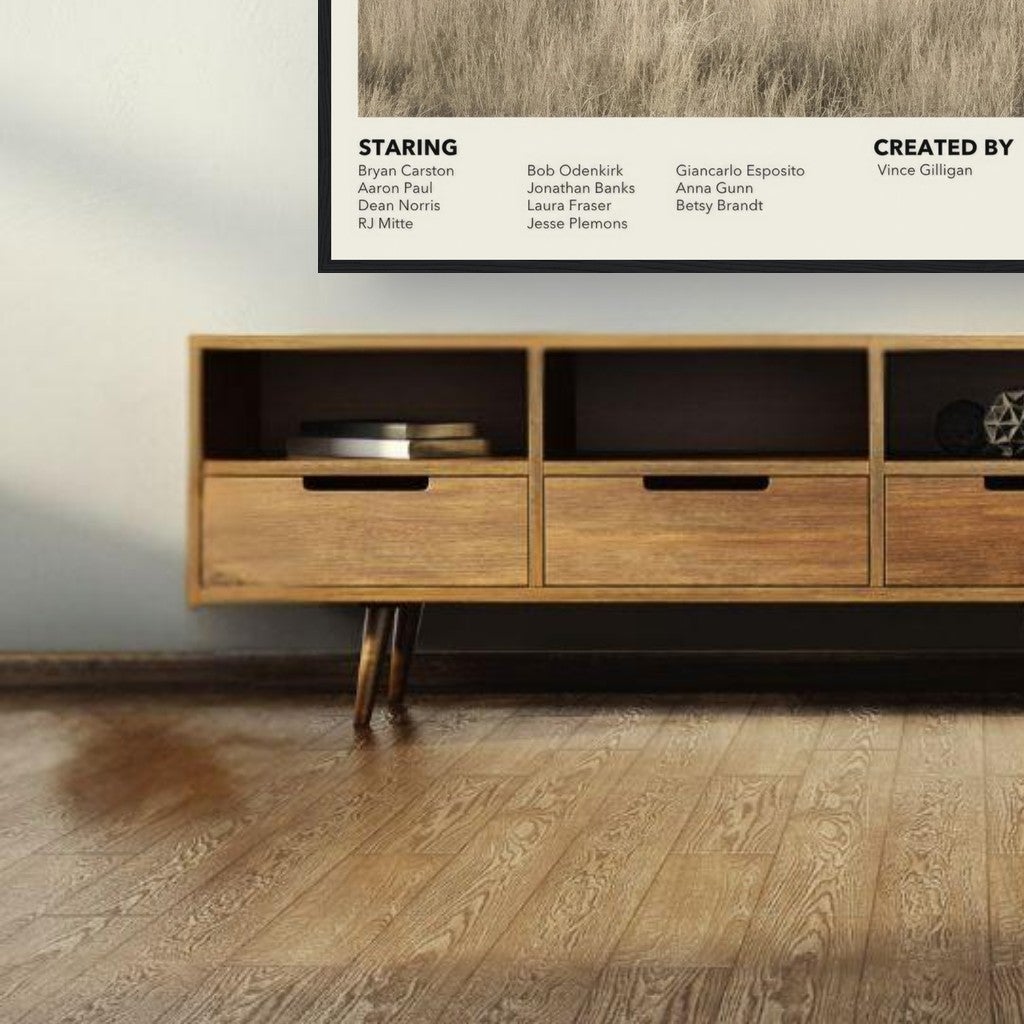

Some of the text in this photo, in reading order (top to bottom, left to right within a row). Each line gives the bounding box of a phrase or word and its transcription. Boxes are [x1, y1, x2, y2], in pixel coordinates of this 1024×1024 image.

[358, 138, 458, 157] STARING
[873, 138, 1015, 157] CREATED BY
[358, 164, 455, 180] Bryan Carston
[527, 164, 623, 177] Bob Odenkirk
[675, 164, 805, 180] Giancarlo Esposito
[877, 163, 973, 180] Vince Gilligan
[358, 181, 433, 194] Aaron Paul
[526, 181, 636, 194] Jonathan Banks
[675, 181, 754, 194] Anna Gunn
[358, 199, 441, 212] Dean Norris
[527, 199, 612, 212] Laura Fraser
[676, 199, 764, 215] Betsy Brandt
[358, 217, 414, 230] RJ Mitte
[526, 217, 628, 230] Jesse Plemons
